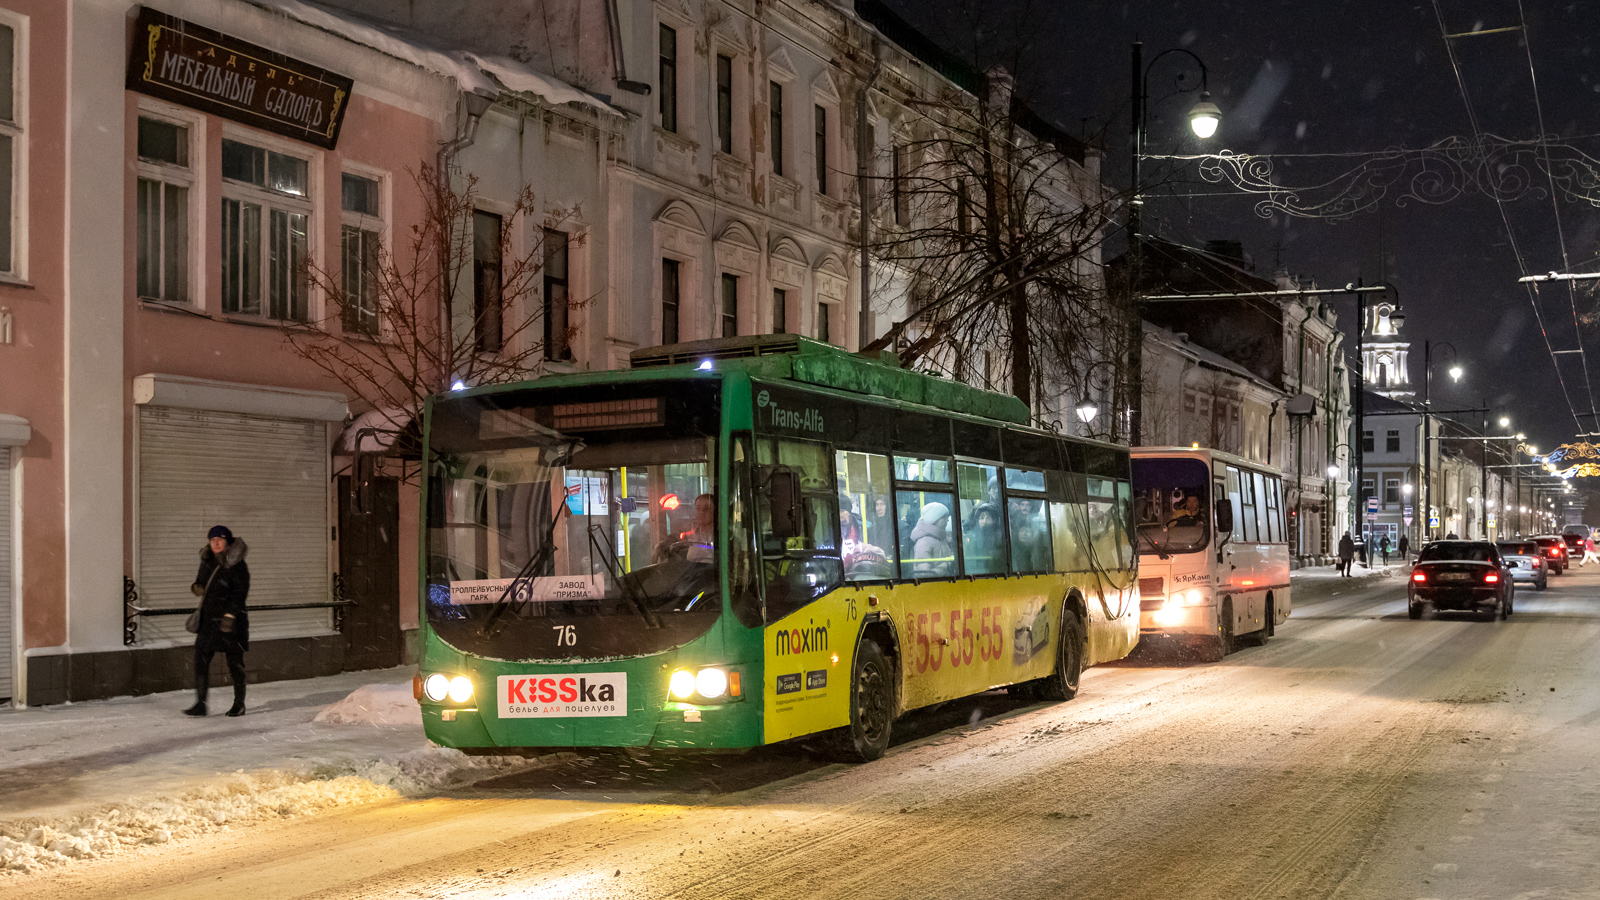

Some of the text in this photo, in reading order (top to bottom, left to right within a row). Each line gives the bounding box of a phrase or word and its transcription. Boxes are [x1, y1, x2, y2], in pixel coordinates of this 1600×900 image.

[160, 50, 323, 126] МЕБЕЛЬНЫЙ САЛОНЪ
[770, 402, 824, 433] Trans-Alfa
[516, 582, 527, 602] 6
[559, 581, 585, 589] ЗАВОД
[845, 598, 857, 622] 76
[553, 625, 577, 647] 76
[509, 704, 615, 714] белье для поцелуев
